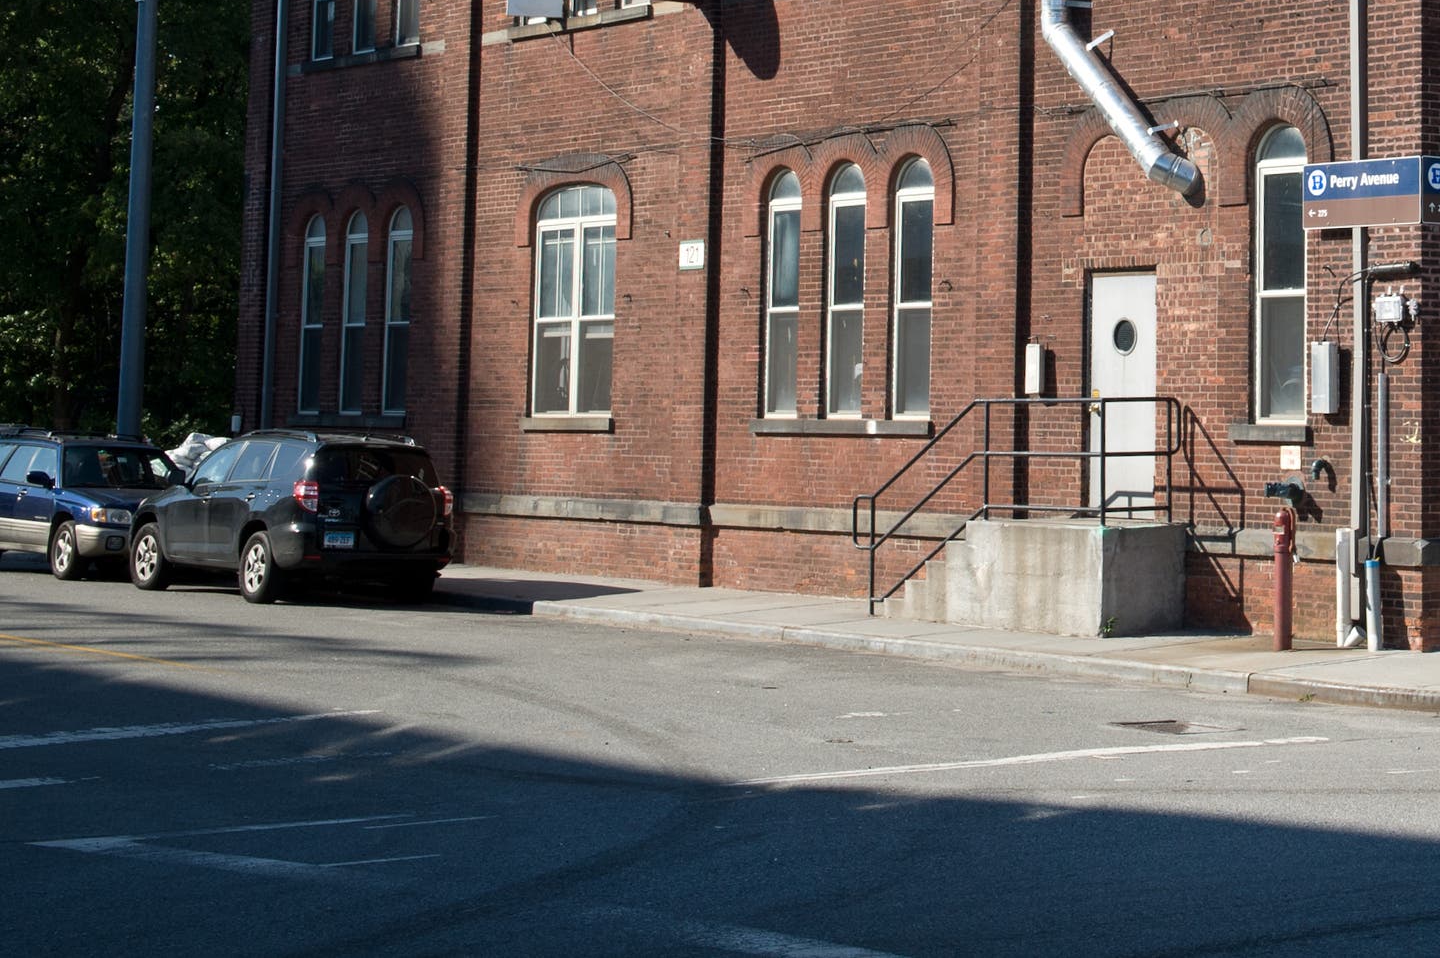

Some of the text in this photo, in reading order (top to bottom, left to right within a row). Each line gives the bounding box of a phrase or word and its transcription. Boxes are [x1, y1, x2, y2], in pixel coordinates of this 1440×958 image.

[1330, 174, 1359, 190] Perry
[1360, 172, 1399, 187] Avenue
[686, 245, 699, 264] 121
